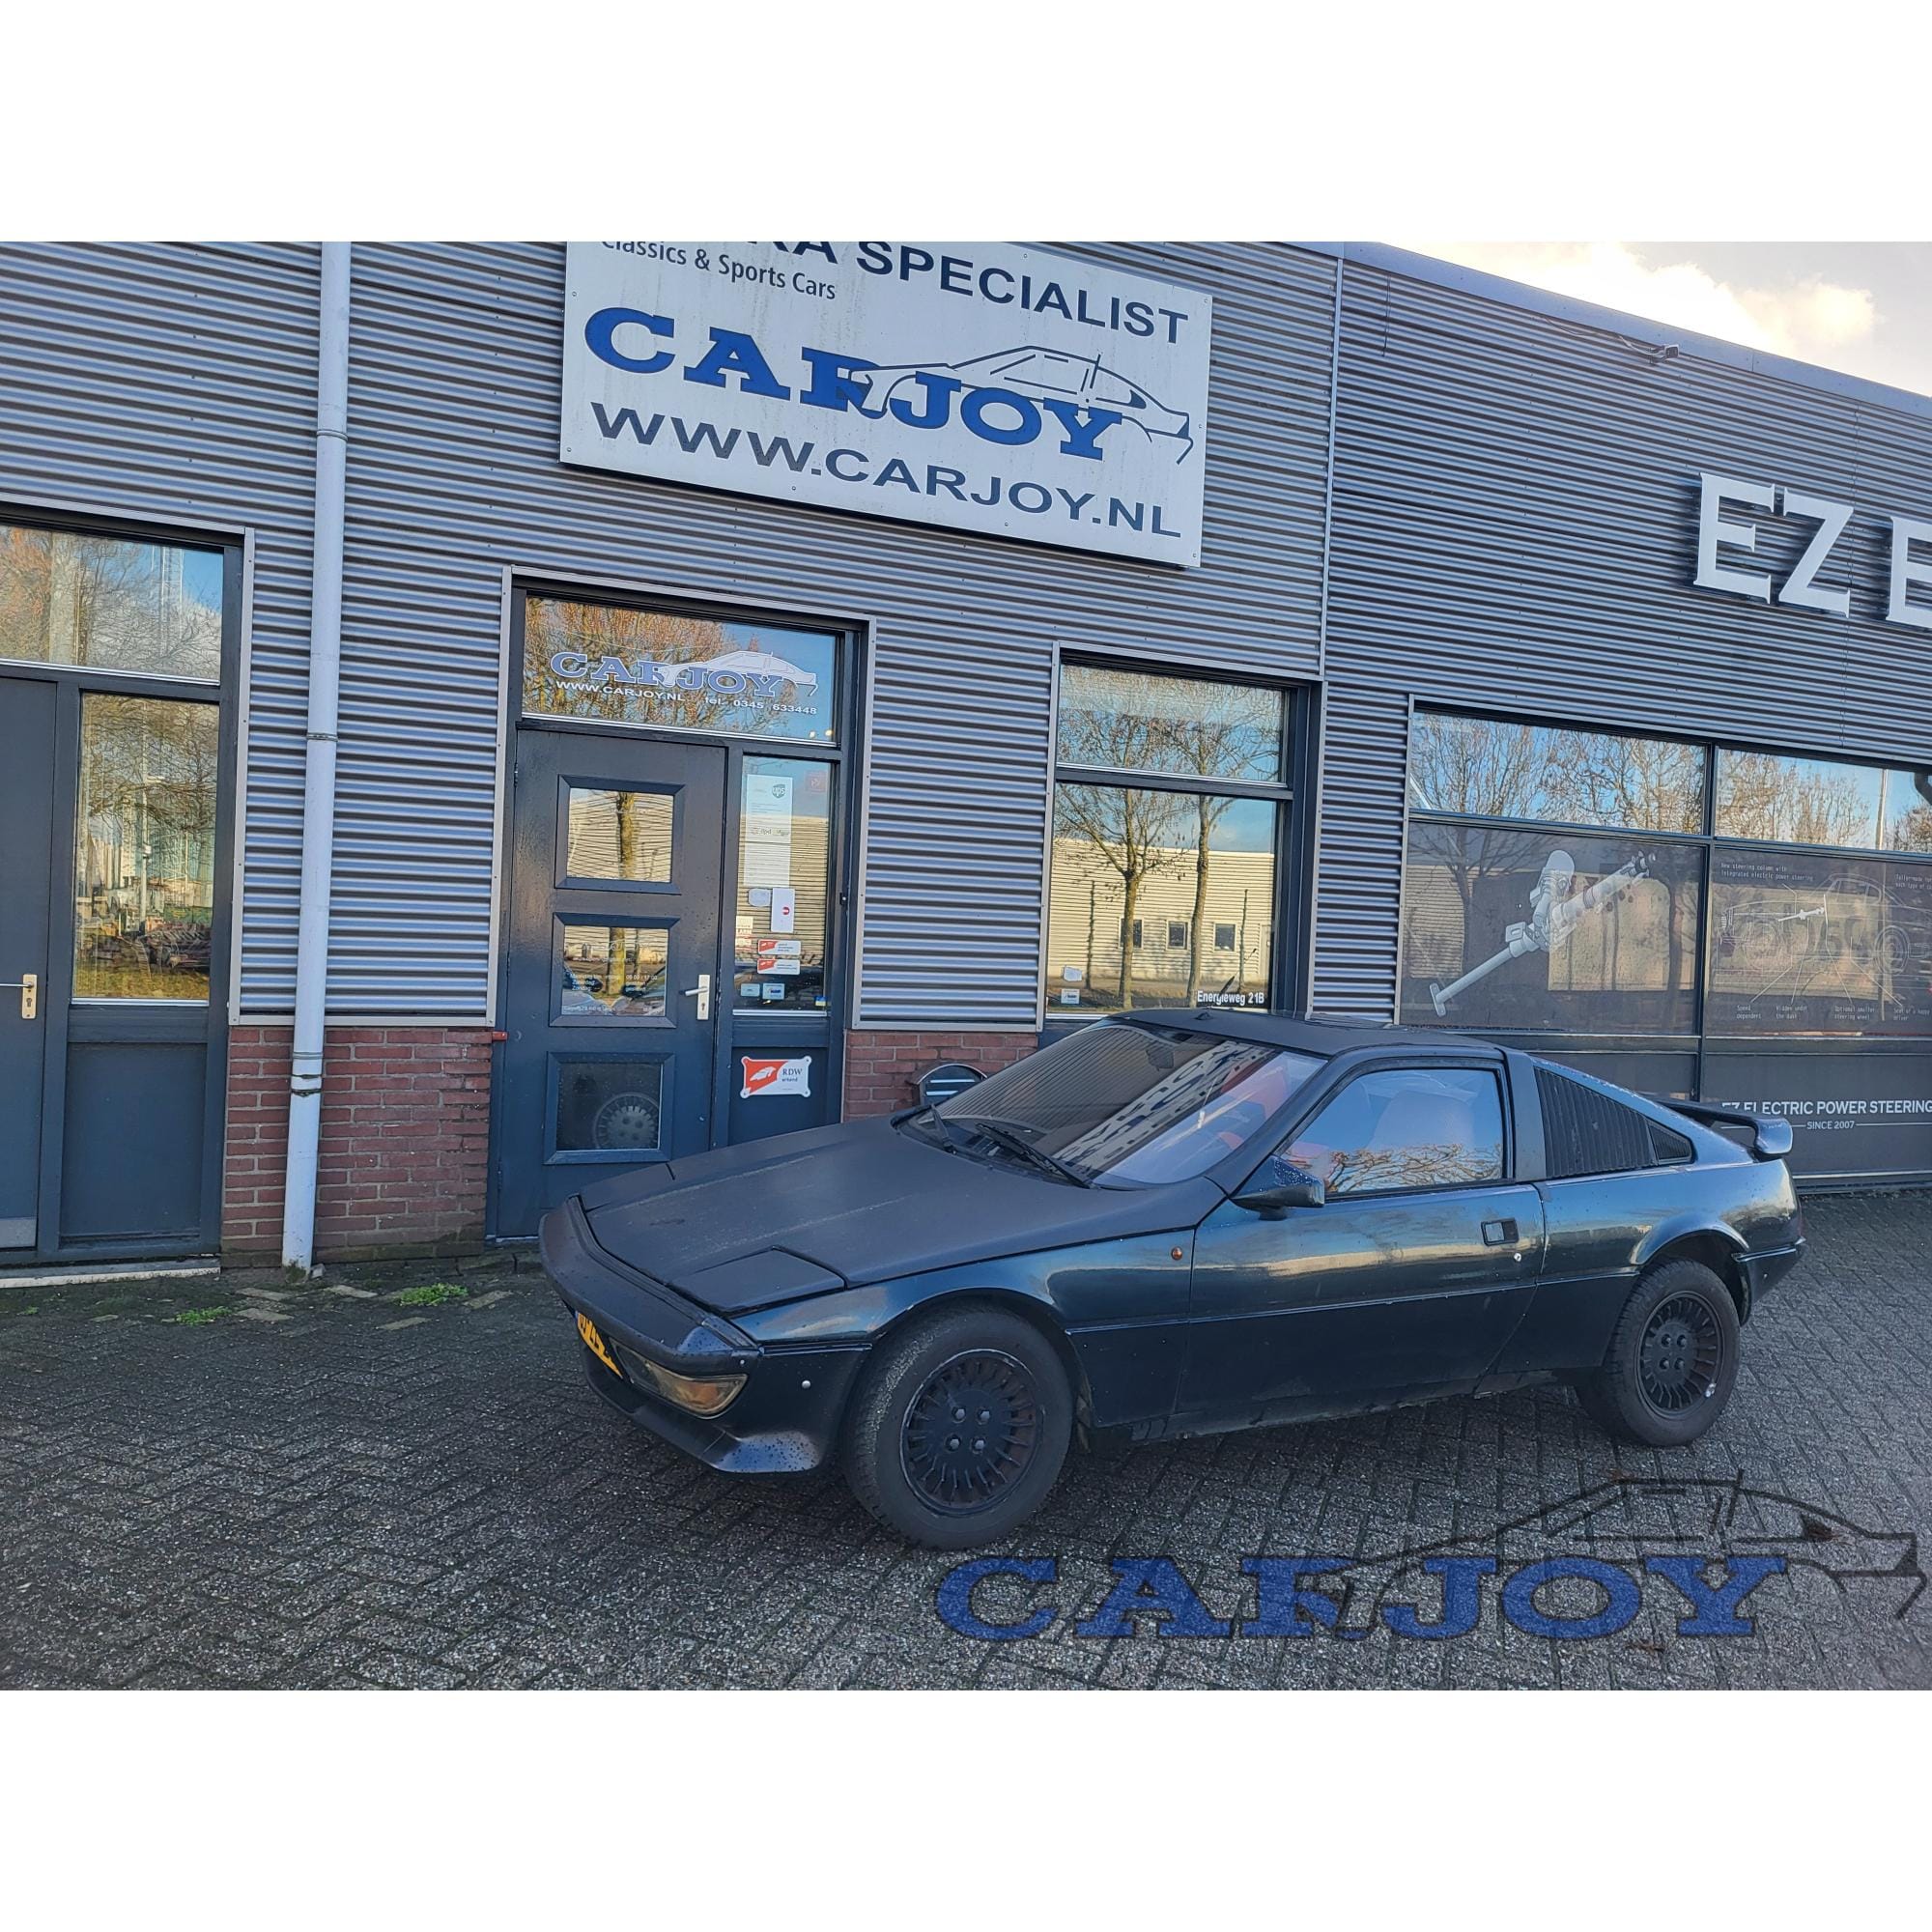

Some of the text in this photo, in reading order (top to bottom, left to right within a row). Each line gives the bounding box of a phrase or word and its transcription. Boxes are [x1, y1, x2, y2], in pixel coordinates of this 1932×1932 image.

[694, 248, 711, 271] &
[718, 254, 785, 283] Sports
[792, 271, 837, 300] Cars
[856, 242, 1188, 344] SPECIALIST
[584, 306, 1122, 461] CARJOY
[590, 401, 1181, 538] WWW.CARJOY.NL
[1692, 472, 1855, 618] EZ
[555, 680, 686, 702] WWW.CARJOY.NL
[732, 699, 765, 710] 0345
[772, 703, 818, 716] 633448
[1197, 990, 1265, 1006] Energieweg 21B
[782, 1067, 803, 1076] RDW
[1744, 1100, 1814, 1115] ELECTRIC
[1816, 1099, 1867, 1115] POWER
[1869, 1099, 1932, 1114] STEERING
[1806, 1120, 1855, 1130] SINCE 2007
